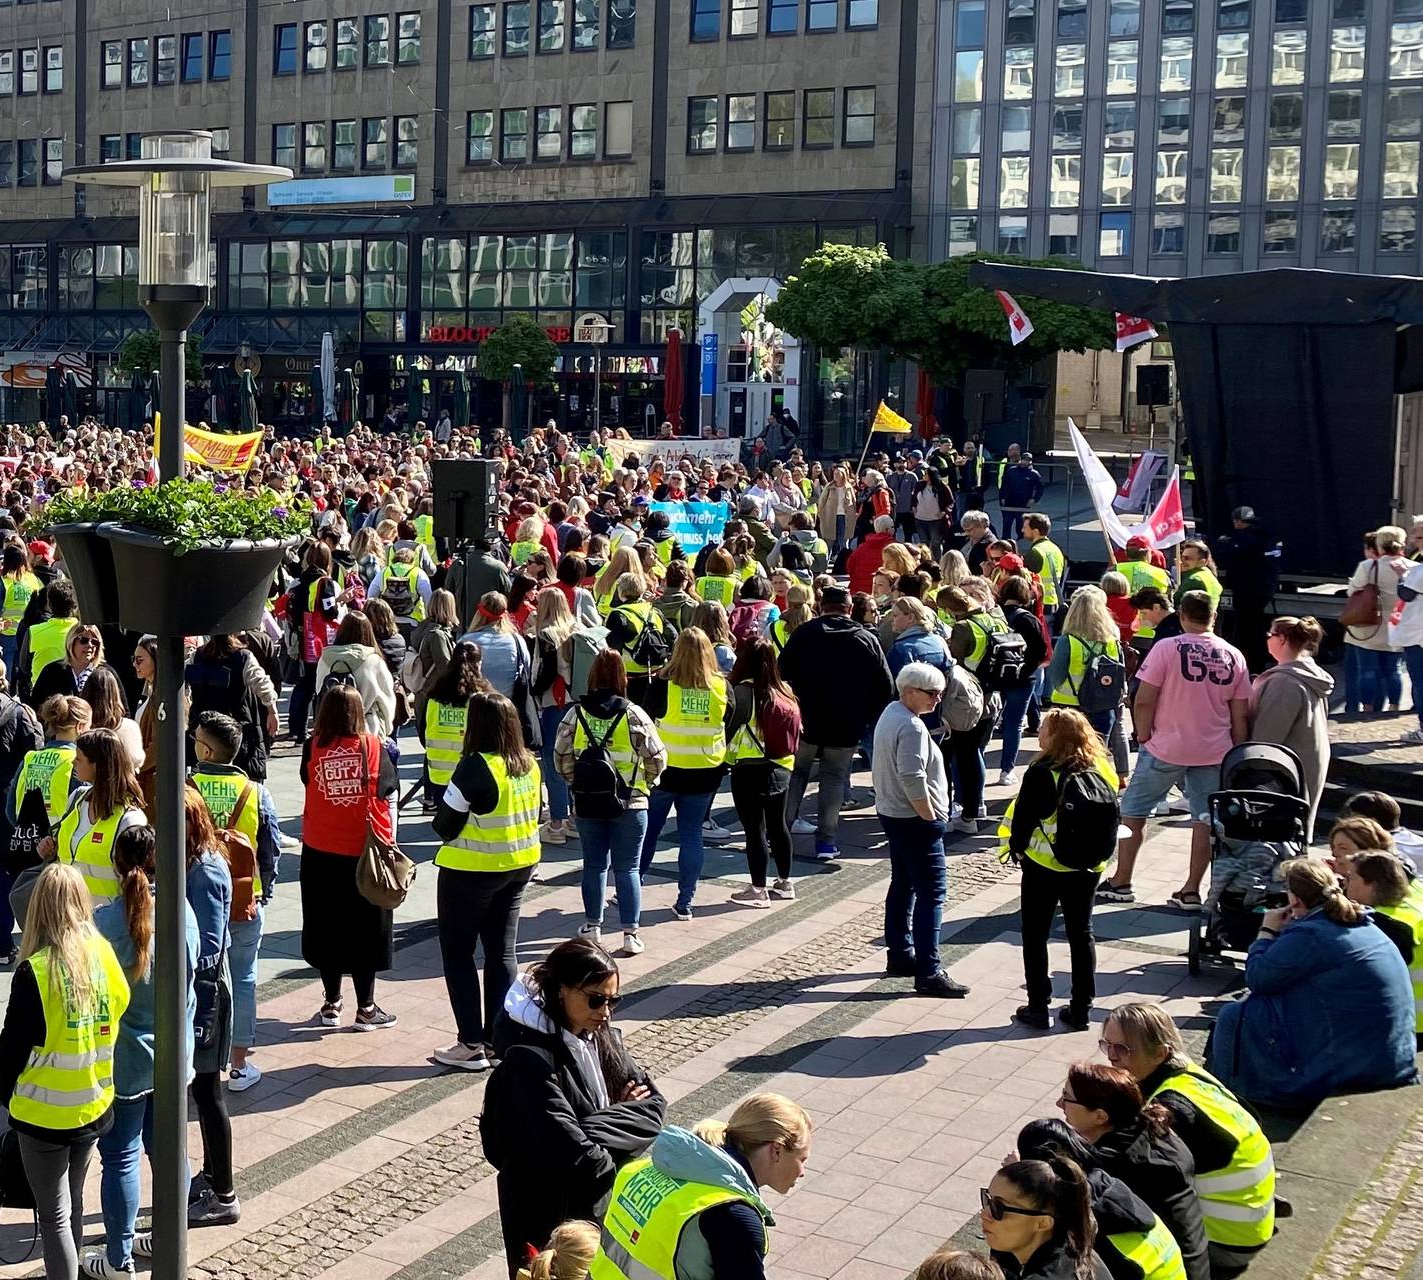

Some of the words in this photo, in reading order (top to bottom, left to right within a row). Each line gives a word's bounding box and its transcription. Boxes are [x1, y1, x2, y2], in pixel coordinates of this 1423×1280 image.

[201, 440, 235, 460] MEHR
[689, 510, 716, 525] mehr
[157, 701, 167, 721] 6
[682, 698, 710, 710] MEHR
[439, 710, 465, 723] MEHR
[32, 751, 60, 766] MEHR
[325, 767, 351, 781] GUT
[200, 780, 237, 797] MEHR
[622, 1172, 664, 1220] MEHR
